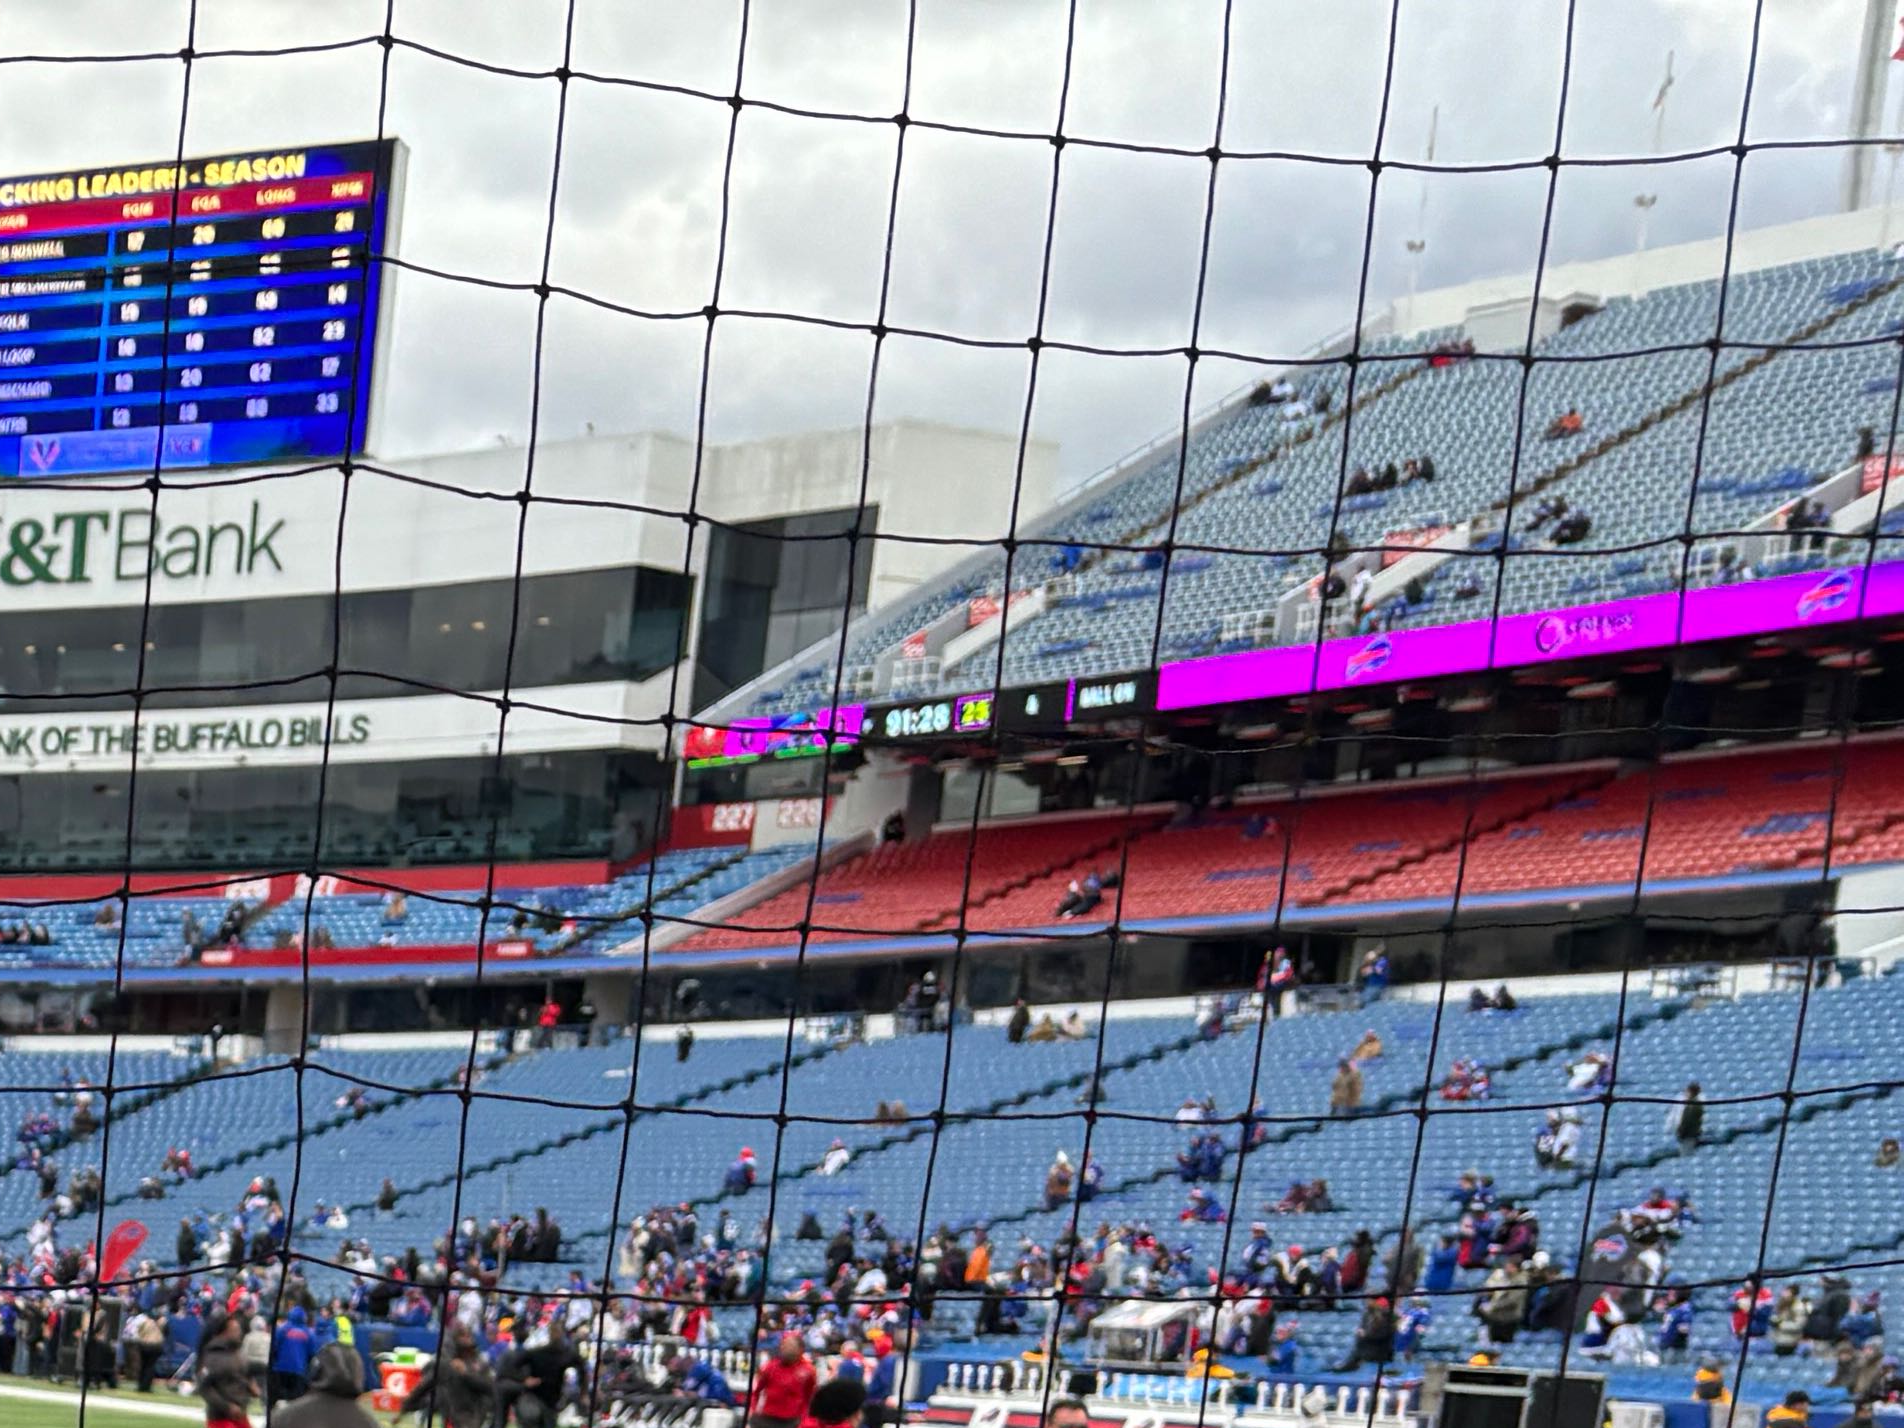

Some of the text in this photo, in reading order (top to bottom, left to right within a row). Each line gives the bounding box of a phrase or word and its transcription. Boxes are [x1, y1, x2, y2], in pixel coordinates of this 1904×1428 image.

[78, 165, 187, 199] LEADERS
[204, 153, 306, 186] SEASON
[115, 501, 285, 582] Bank
[42, 724, 80, 755] OF
[90, 724, 146, 753] THE
[154, 719, 284, 753] BUFFALO
[290, 714, 372, 746] BILLS
[886, 703, 951, 738] 91:28
[711, 803, 753, 831] 227
